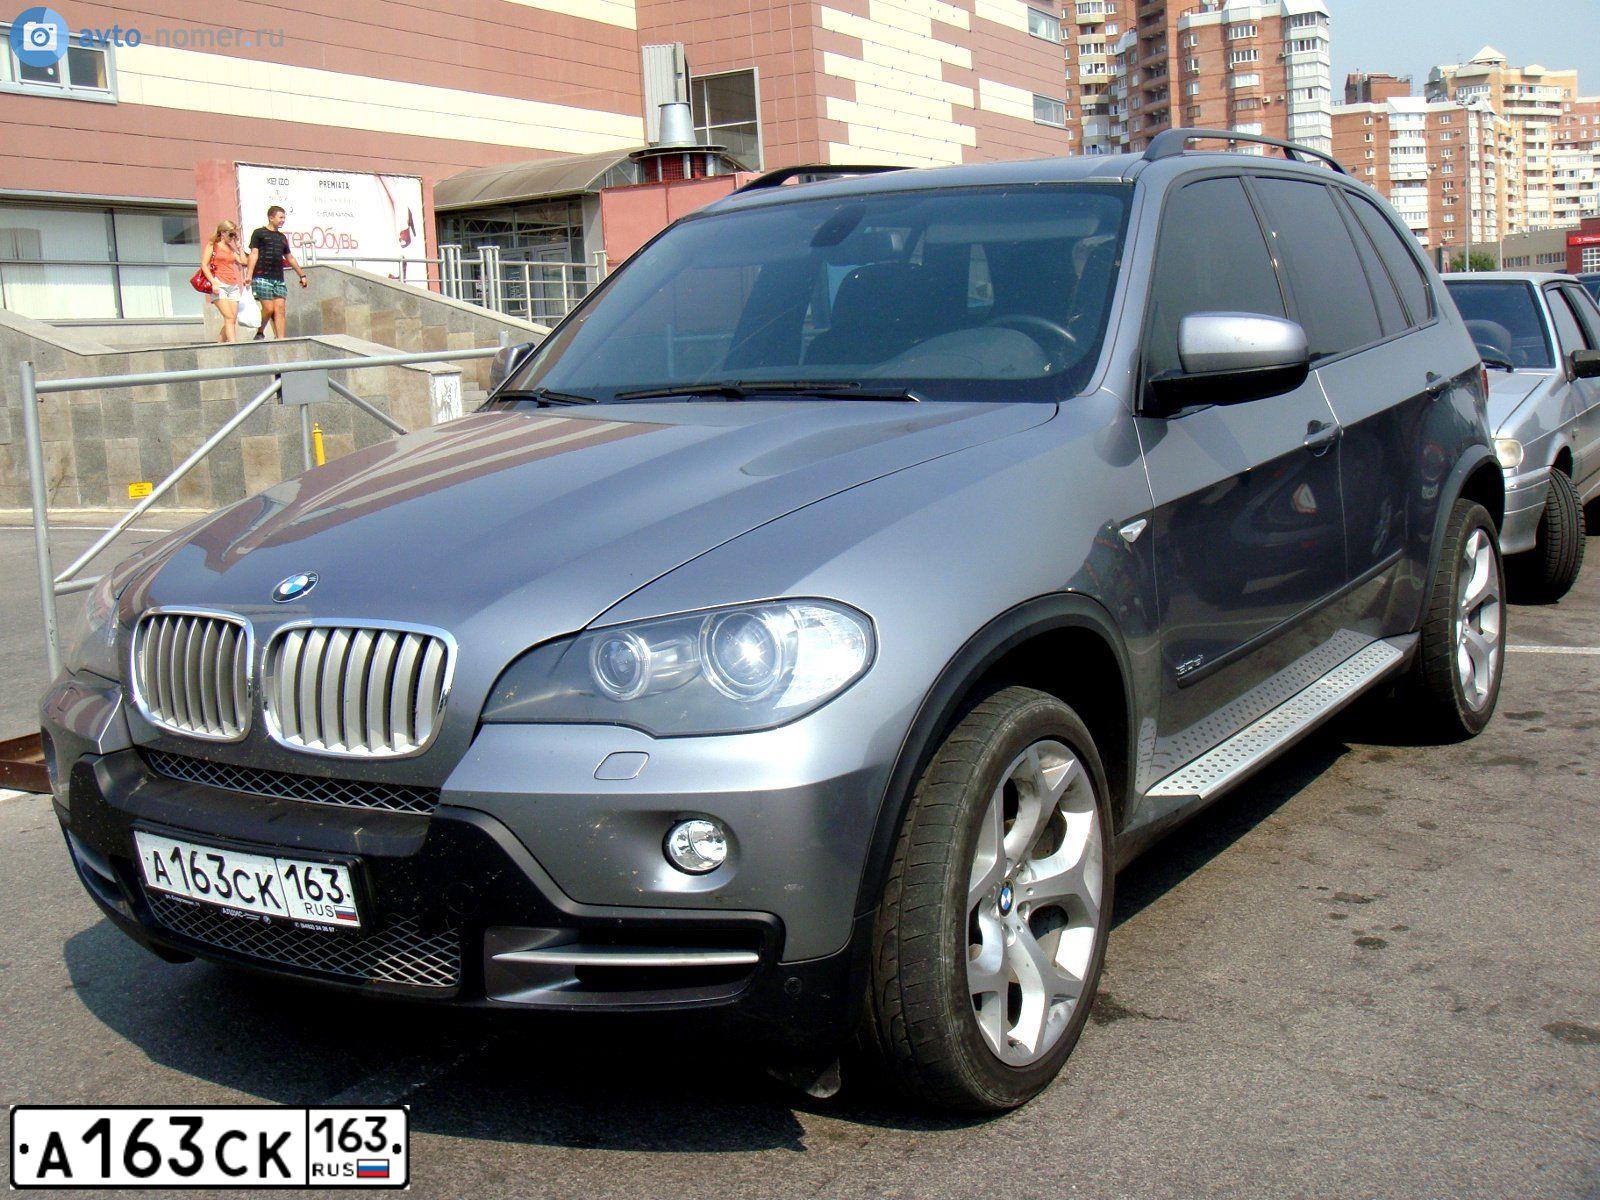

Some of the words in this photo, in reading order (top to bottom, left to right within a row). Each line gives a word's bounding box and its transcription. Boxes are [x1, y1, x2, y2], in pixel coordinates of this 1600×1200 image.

[319, 180, 350, 190] PREMIATA
[153, 846, 282, 909] А163СК
[284, 864, 345, 904] 163
[304, 901, 335, 918] RUS
